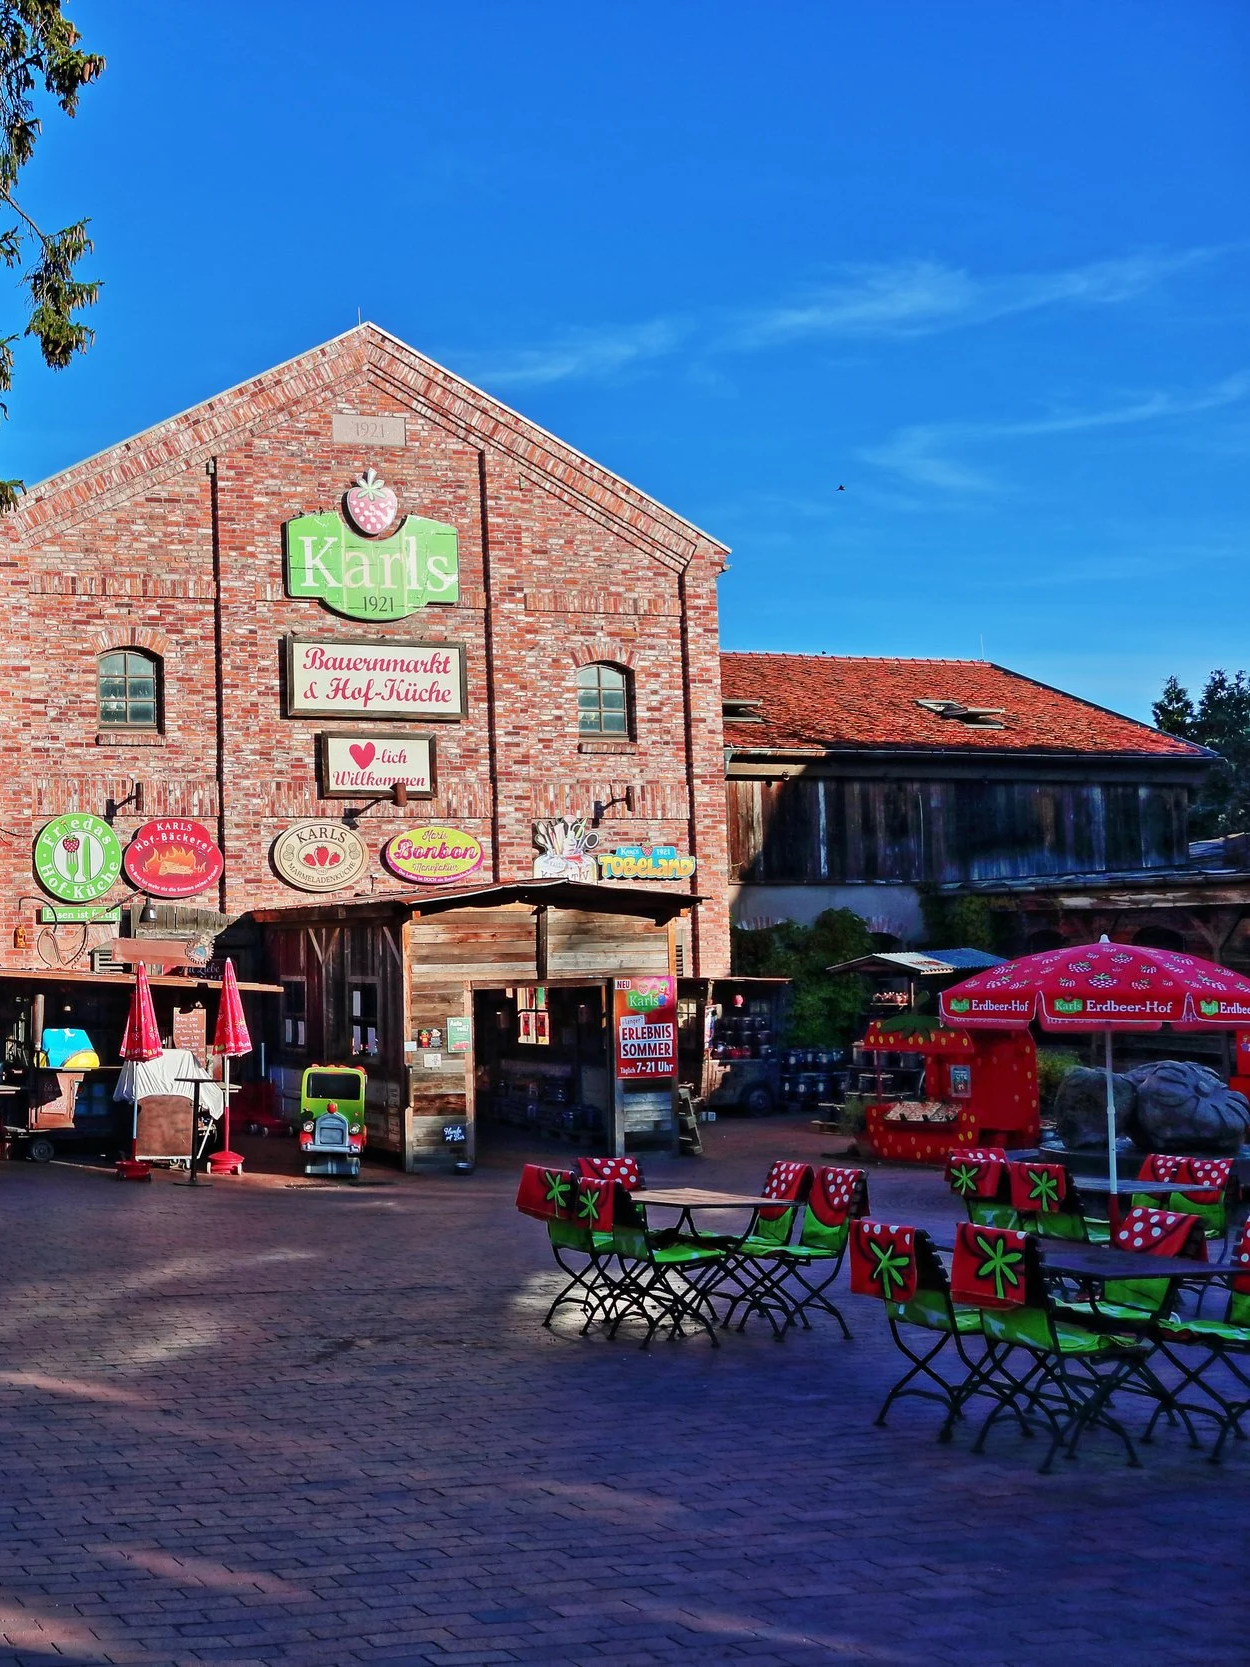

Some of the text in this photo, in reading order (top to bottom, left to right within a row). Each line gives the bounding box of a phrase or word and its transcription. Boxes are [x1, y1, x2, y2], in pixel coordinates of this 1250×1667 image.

[355, 421, 385, 438] 1921
[298, 535, 459, 592] Karls
[362, 596, 395, 612] 1921
[302, 646, 452, 675] Bauernmarkt
[303, 677, 452, 708] & Hof-Küche
[332, 770, 426, 788] Willkommen
[42, 818, 111, 847] Fredas
[156, 822, 192, 831] KARLS
[135, 832, 213, 853] Hof-Bäckerei
[296, 827, 347, 844] KARLS
[393, 838, 479, 860] Bonbon
[40, 862, 118, 898] Hof-Küche
[77, 909, 89, 919] ist
[630, 995, 659, 1007] Karls
[972, 1000, 1029, 1012] Erdbeer-Hof
[1086, 1000, 1173, 1013] Erdbeer-Hof
[622, 1025, 672, 1041] ERLEBNIS
[622, 1042, 671, 1057] SOMMER
[636, 1062, 655, 1073] 7-21
[657, 1061, 674, 1072] Uhr
